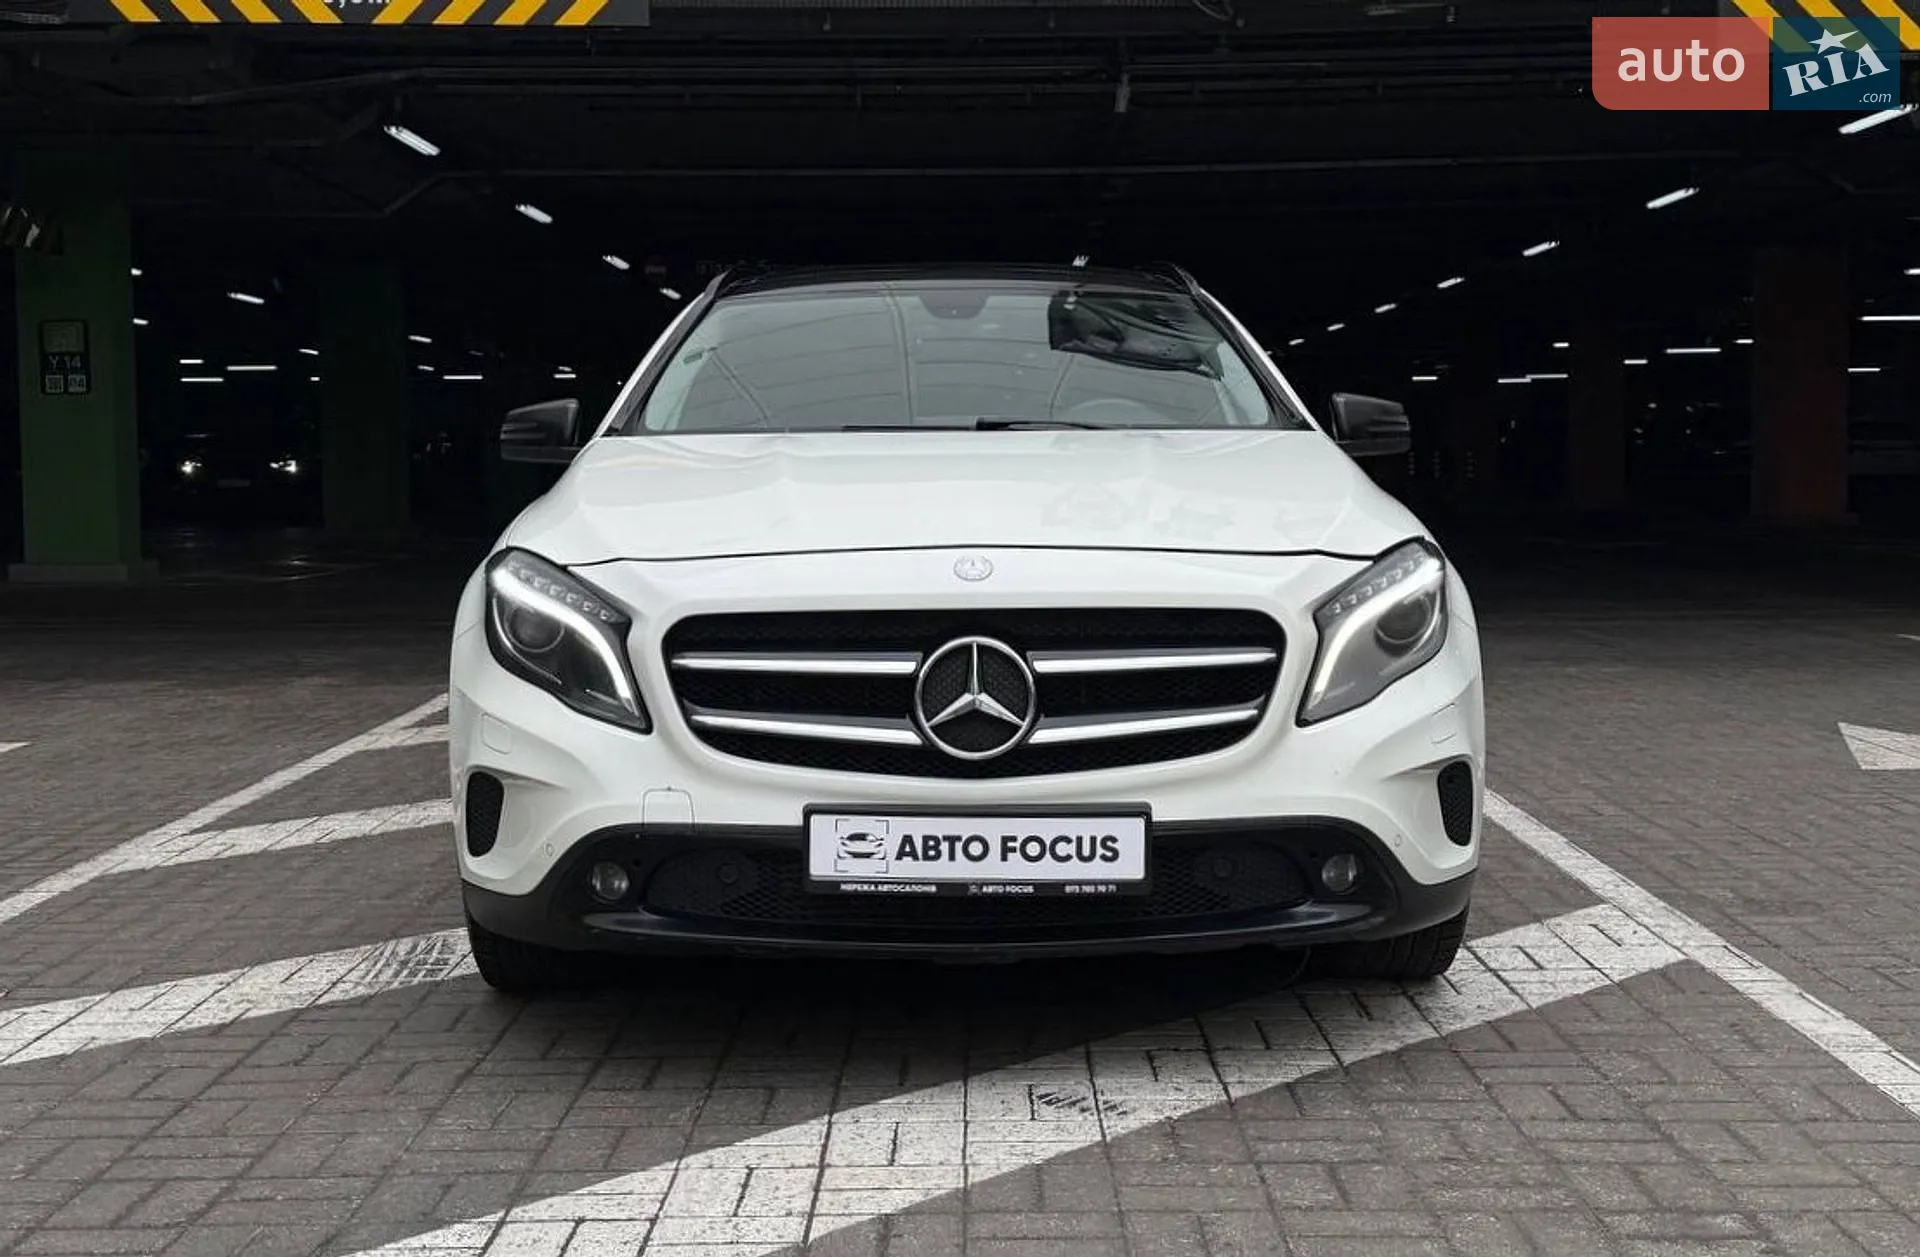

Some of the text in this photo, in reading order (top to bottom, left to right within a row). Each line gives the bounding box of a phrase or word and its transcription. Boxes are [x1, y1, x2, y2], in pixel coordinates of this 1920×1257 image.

[895, 835, 1120, 863] АВТО FOCUS
[1005, 885, 1034, 894] FOCUS
